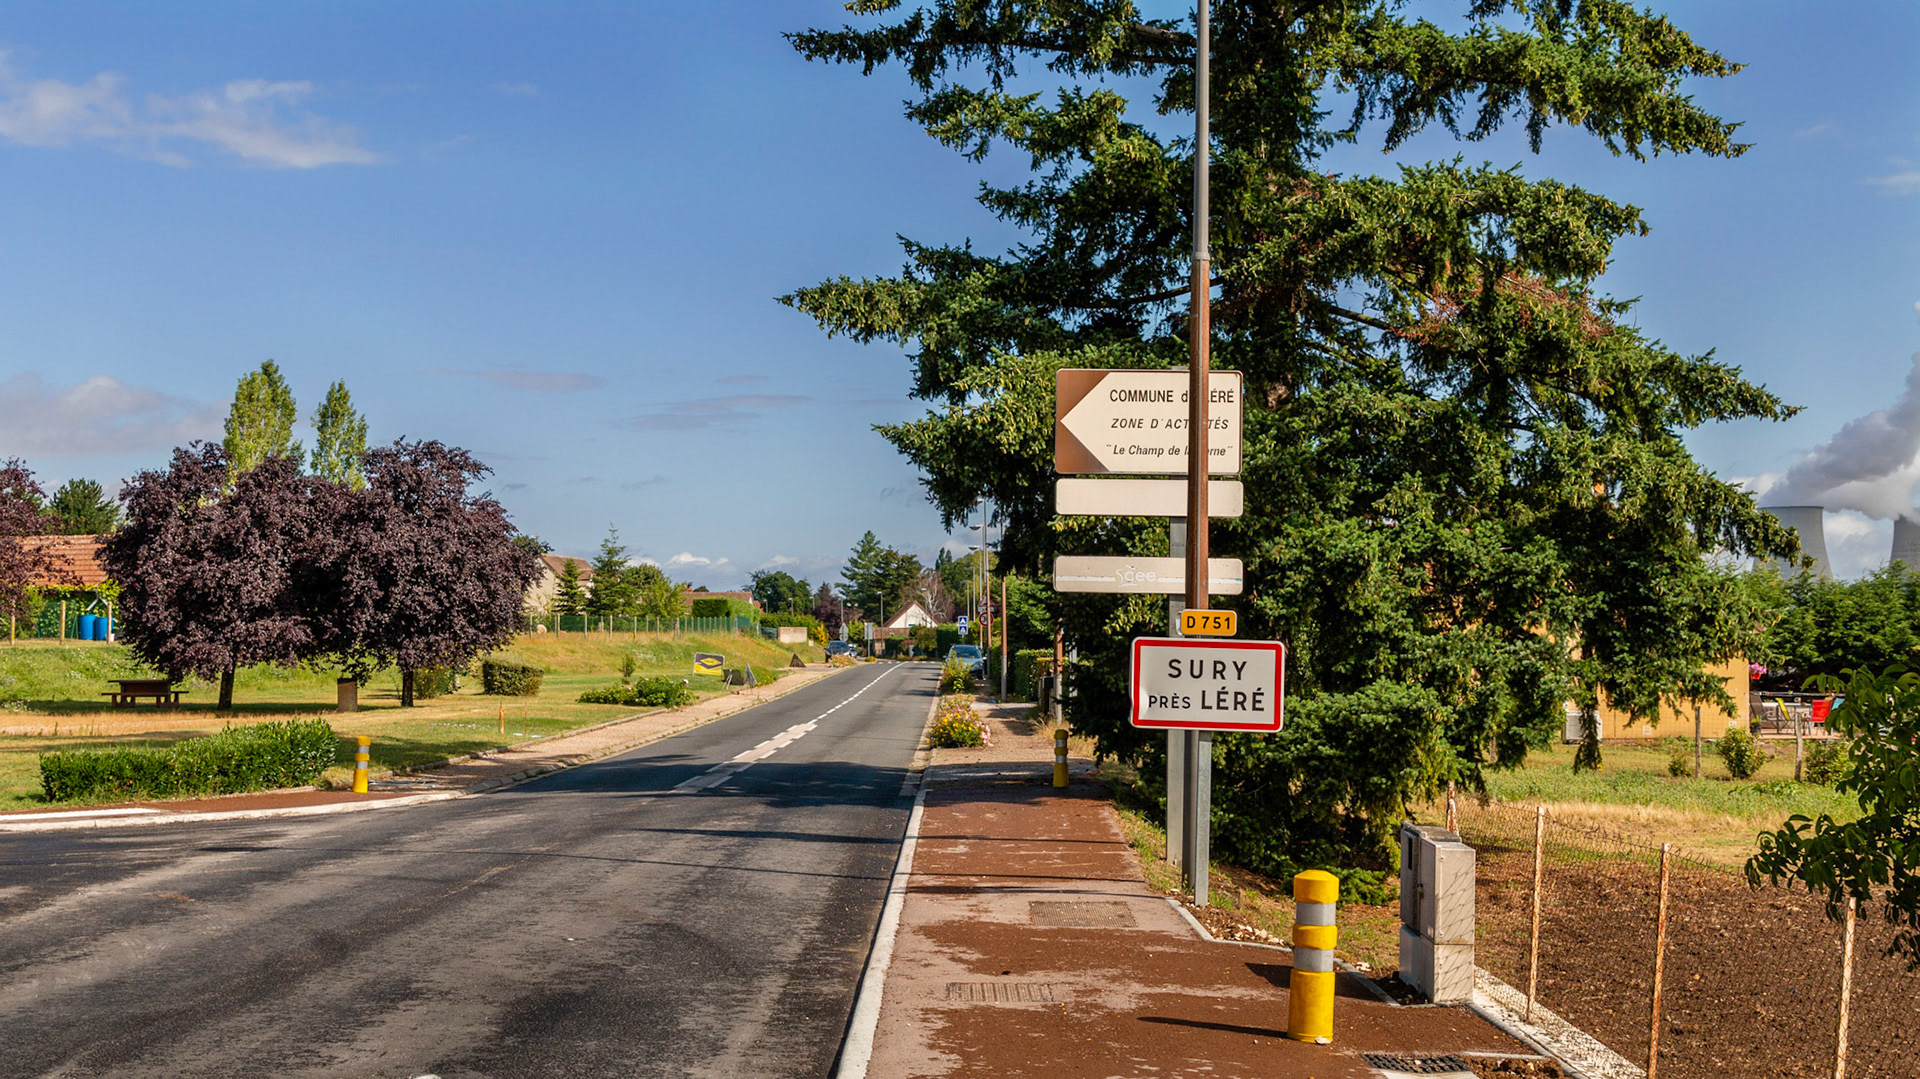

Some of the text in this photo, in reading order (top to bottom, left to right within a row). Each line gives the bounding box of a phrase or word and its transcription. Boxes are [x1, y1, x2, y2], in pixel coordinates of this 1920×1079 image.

[1109, 389, 1174, 403] COMMUNE
[1208, 387, 1235, 403] ÉRÉ
[1111, 418, 1144, 429] ZONE
[1128, 445, 1163, 458] Champ
[1168, 445, 1181, 456] de
[1186, 616, 1231, 630] D 751
[1167, 658, 1247, 681] SURY
[1148, 686, 1265, 712] PRÈS LÉRÉ
